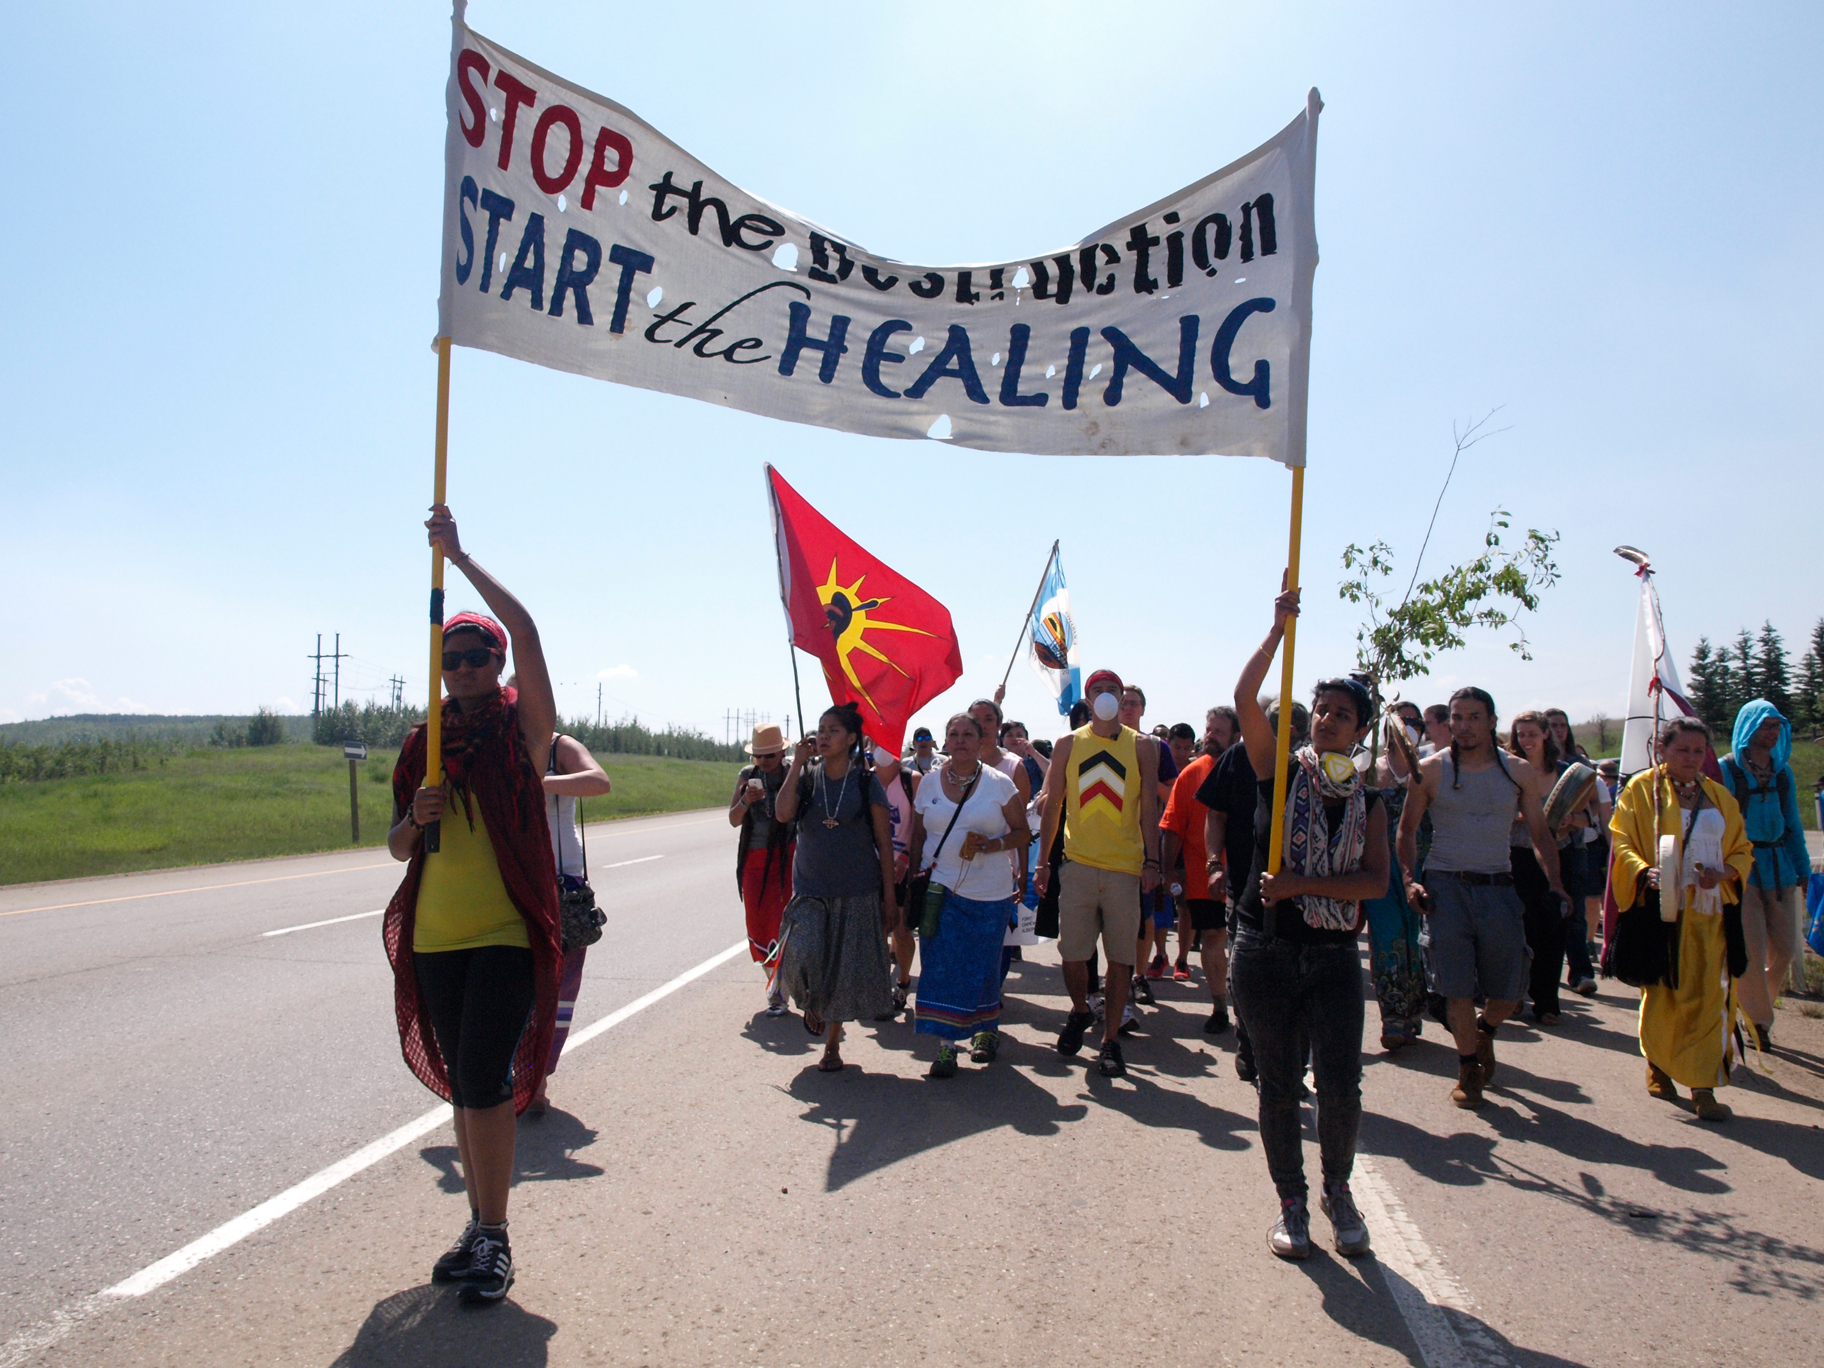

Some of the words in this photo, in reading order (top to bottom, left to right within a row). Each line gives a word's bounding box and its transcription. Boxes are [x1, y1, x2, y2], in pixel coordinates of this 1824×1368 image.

[457, 48, 634, 211] STOP
[649, 171, 786, 252] the
[456, 175, 655, 334] START
[644, 281, 811, 364] the
[778, 297, 1277, 410] HEALING
